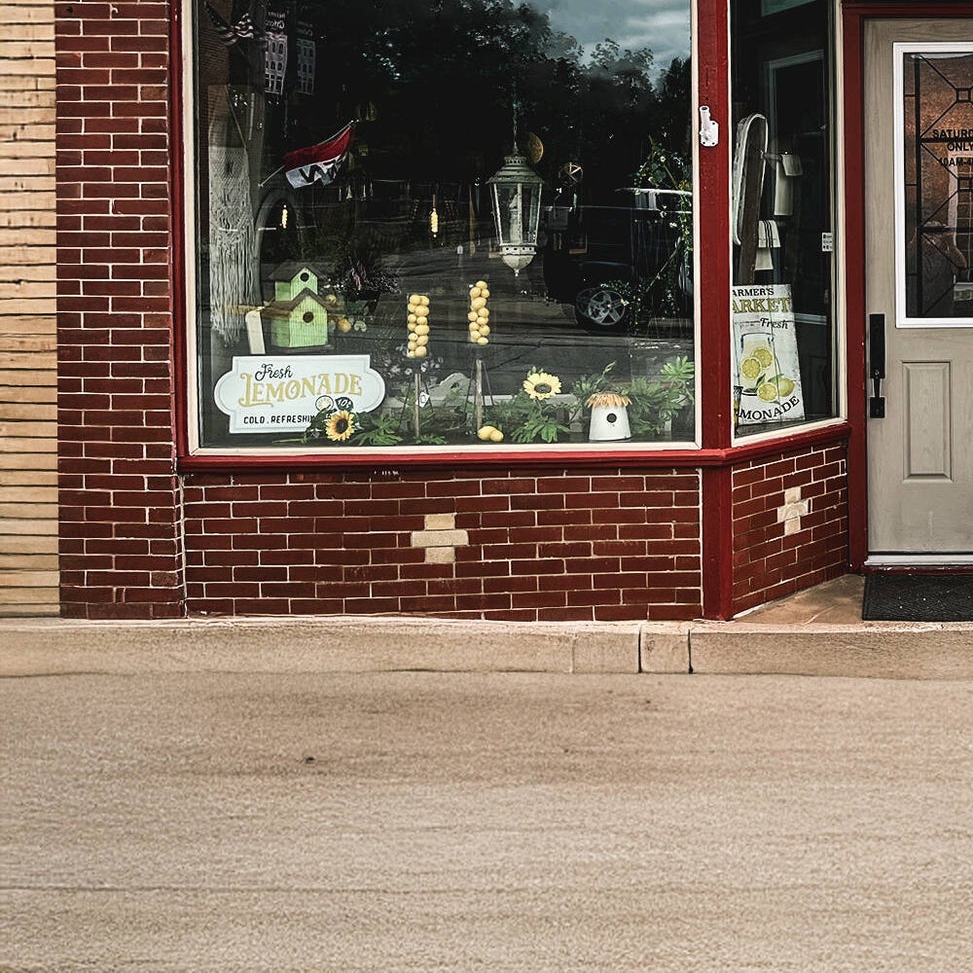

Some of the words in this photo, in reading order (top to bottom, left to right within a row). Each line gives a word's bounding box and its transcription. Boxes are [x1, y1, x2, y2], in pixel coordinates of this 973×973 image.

[947, 142, 973, 151] ONLY
[733, 288, 774, 297] ARMER'S
[733, 298, 790, 313] ARKET
[760, 317, 788, 329] Fresh
[254, 364, 293, 382] Fresh
[238, 373, 363, 407] LEMONADE
[739, 396, 799, 420] MONADE
